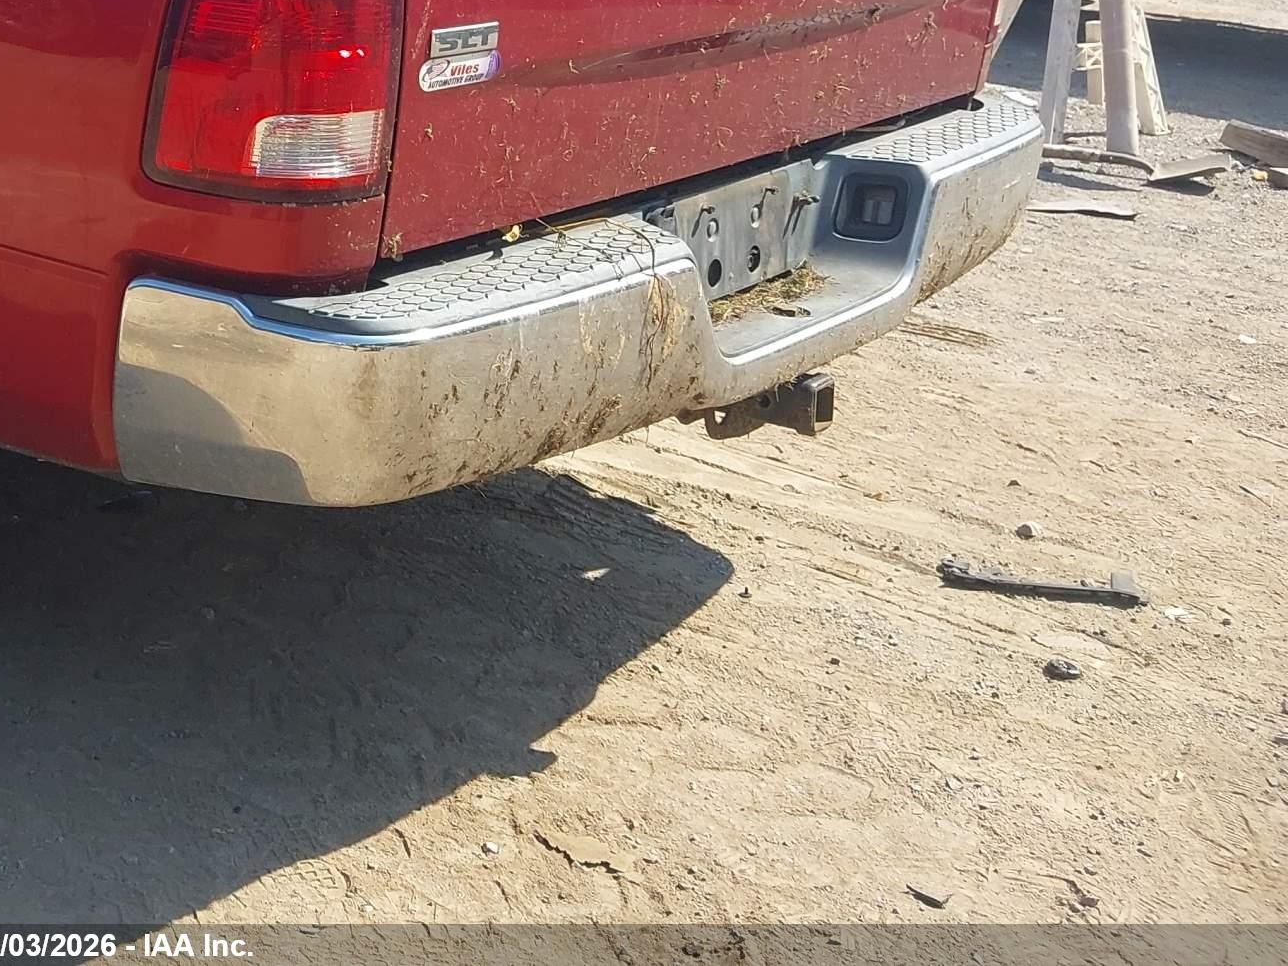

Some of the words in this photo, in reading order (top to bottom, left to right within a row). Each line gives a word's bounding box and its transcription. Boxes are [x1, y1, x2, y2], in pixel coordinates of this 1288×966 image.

[438, 25, 499, 52] SLT
[428, 76, 463, 89] AUTOMOTIVE
[463, 73, 485, 83] GROUP
